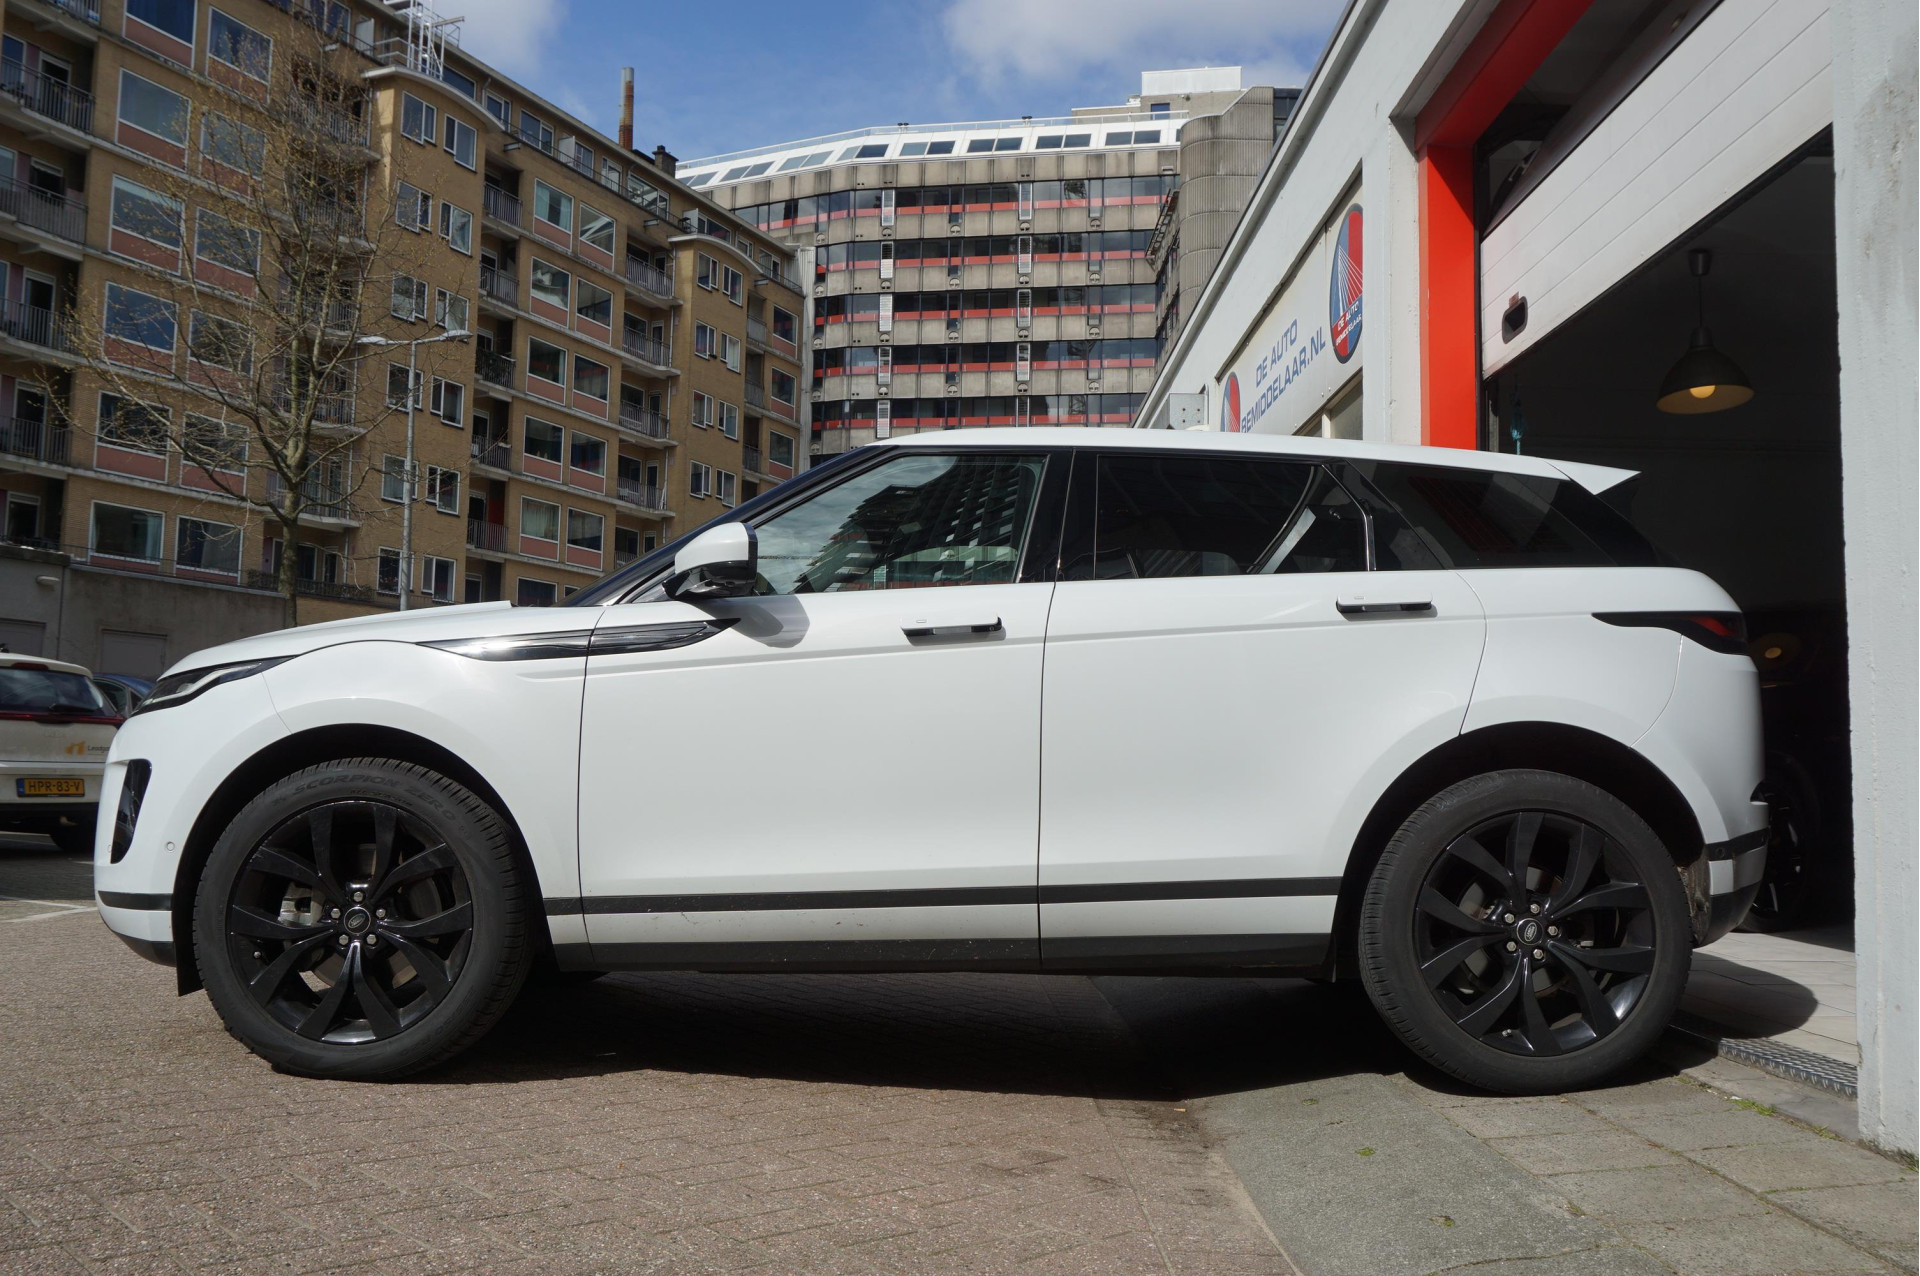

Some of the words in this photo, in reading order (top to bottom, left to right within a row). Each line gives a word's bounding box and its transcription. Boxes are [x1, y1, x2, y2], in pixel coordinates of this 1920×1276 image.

[1241, 327, 1326, 433] BEMIDDELAAR.NL
[1256, 356, 1267, 388] DE
[1269, 318, 1298, 370] AUTO
[28, 781, 80, 792] HPR-83-V
[292, 774, 400, 795] SCORPION
[405, 788, 457, 820] ZERO
